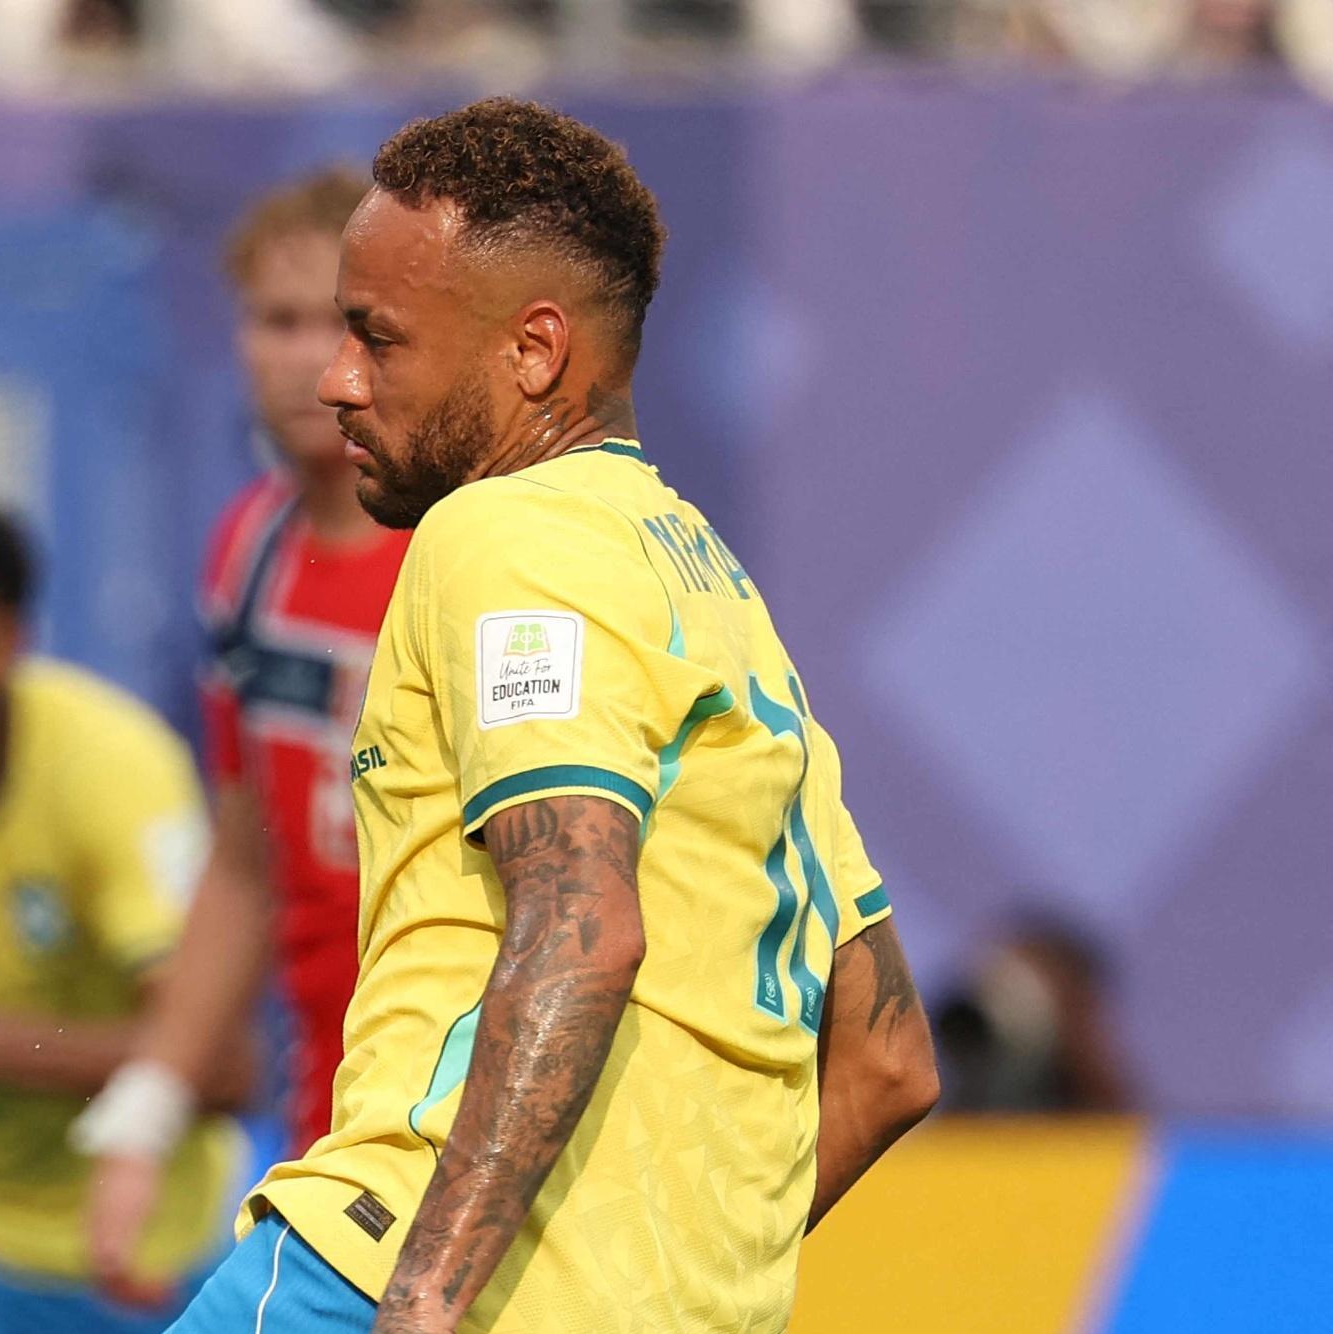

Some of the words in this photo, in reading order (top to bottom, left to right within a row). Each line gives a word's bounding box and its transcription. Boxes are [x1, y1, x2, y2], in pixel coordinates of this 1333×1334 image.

[499, 660, 531, 679] Unite
[533, 658, 551, 675] For
[492, 679, 561, 702] EDUCATION
[511, 698, 535, 710] FIFA
